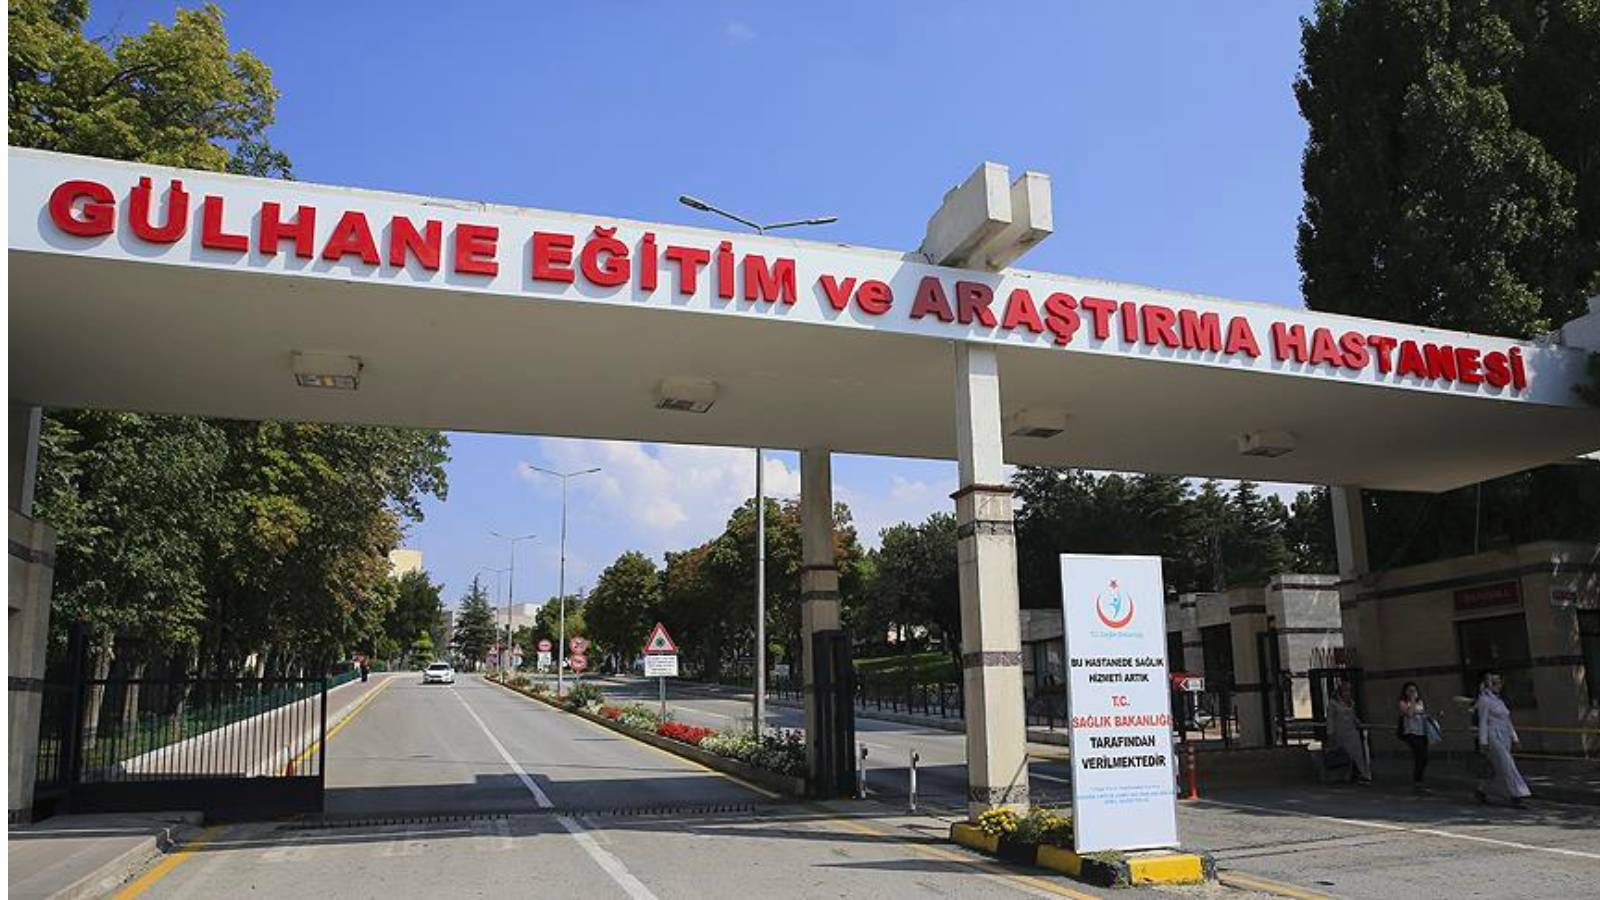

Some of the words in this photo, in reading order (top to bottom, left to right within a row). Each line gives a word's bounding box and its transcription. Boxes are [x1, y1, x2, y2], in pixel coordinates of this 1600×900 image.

[48, 176, 499, 278] GÜLHANE
[531, 225, 797, 306] EĞİTİM
[818, 275, 893, 315] ve
[910, 276, 1261, 360] ARAŞTIRMA
[1271, 321, 1527, 391] HASTANESİ
[1071, 658, 1082, 667] BU
[1085, 657, 1133, 667] HASTANEDE
[1135, 656, 1164, 667] SAĞLIK
[1089, 672, 1122, 682] HİZMETİ
[1125, 673, 1150, 682] ARTIK
[1111, 695, 1131, 707] T.C.
[1072, 714, 1112, 728] SAĞLIK
[1090, 735, 1155, 748] TARAFINDAN
[1082, 753, 1166, 769] VERİLMEKTEDİR
